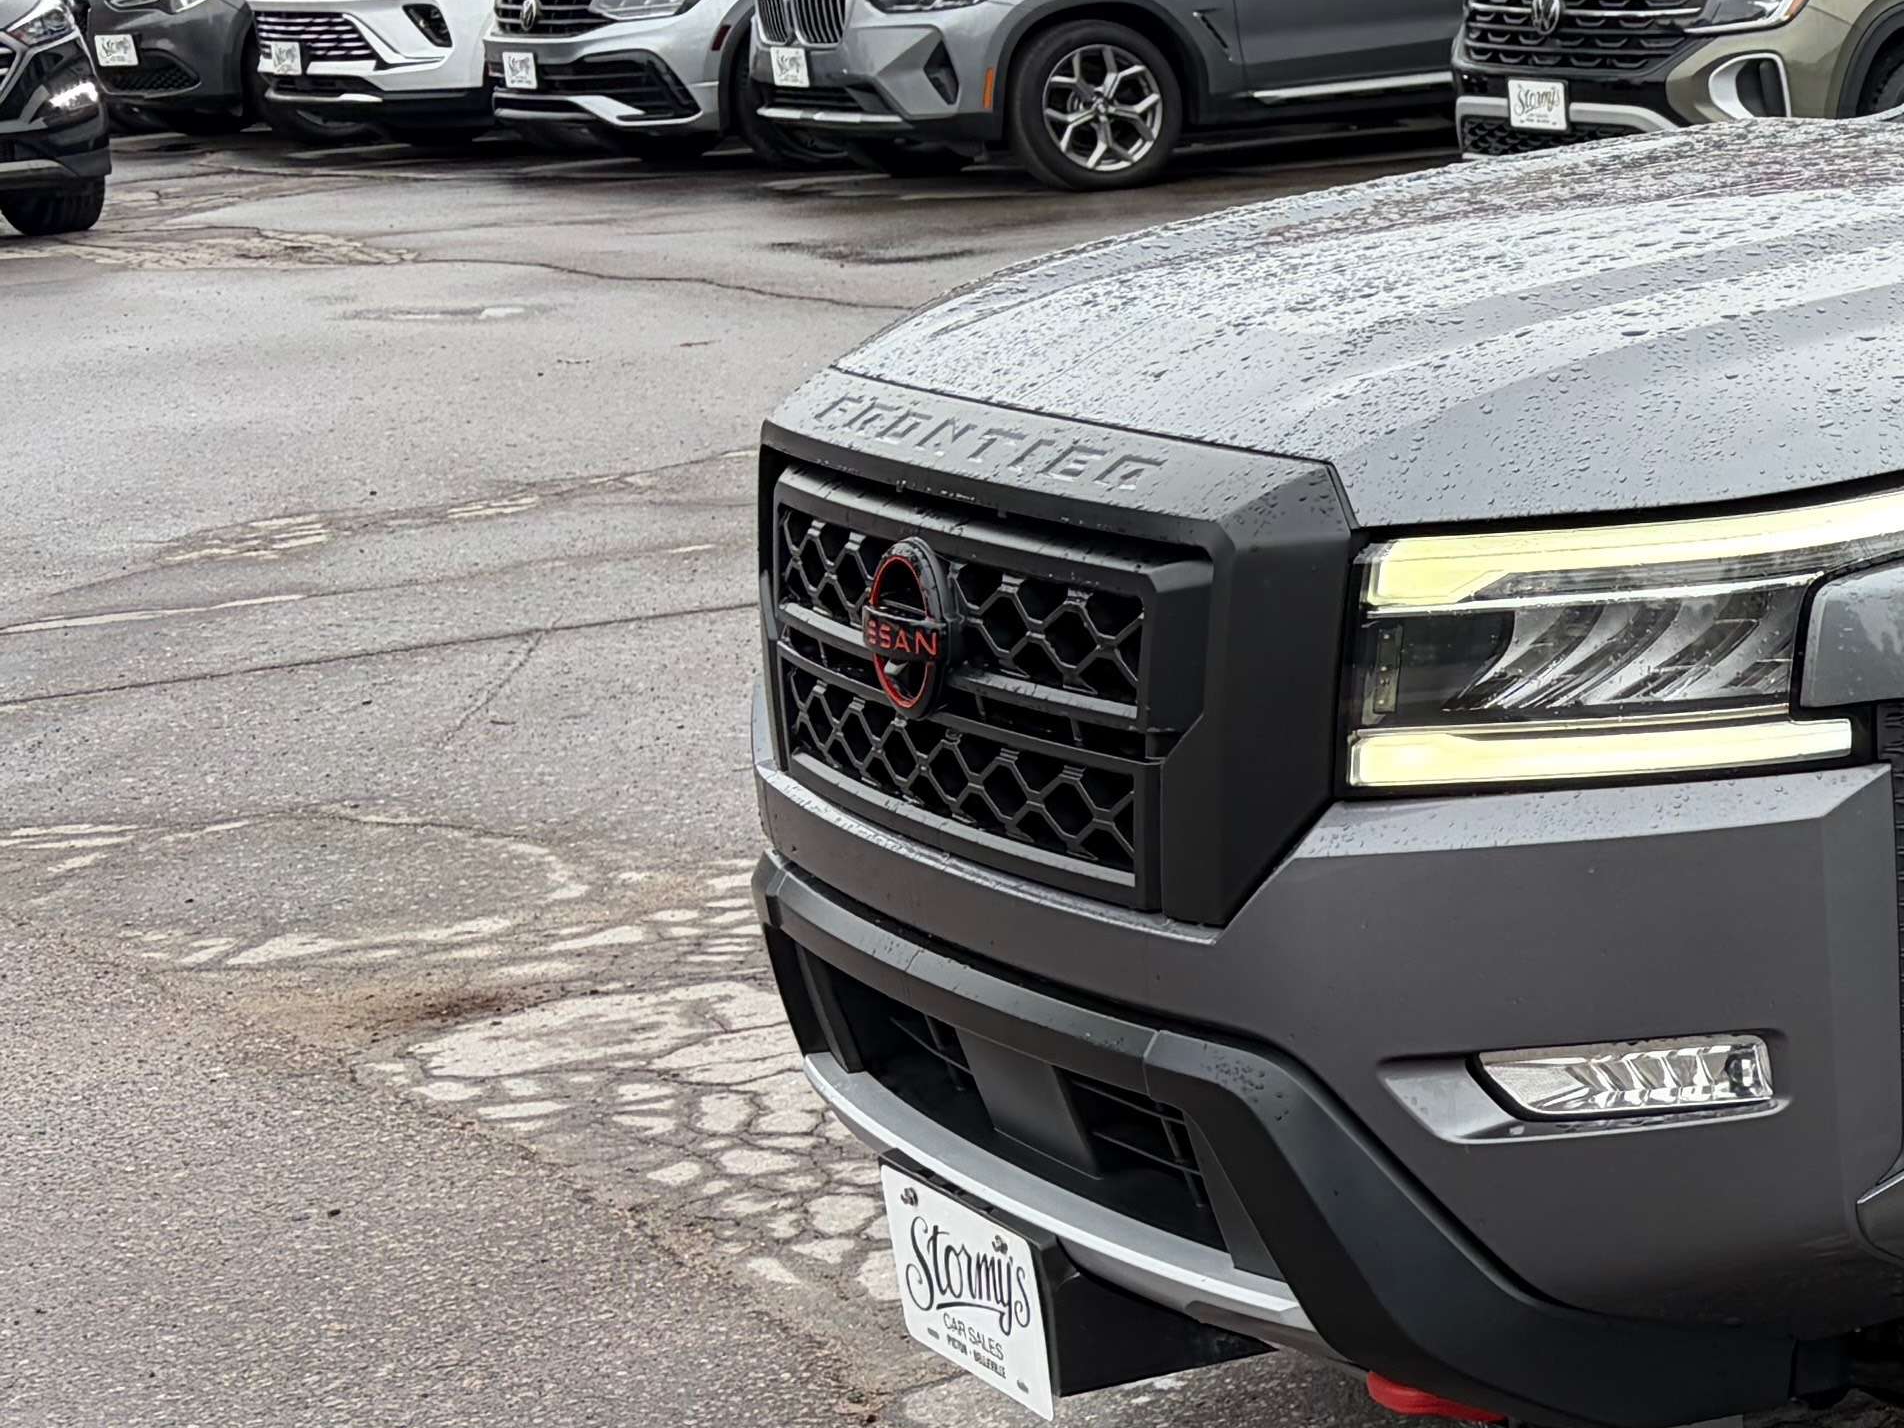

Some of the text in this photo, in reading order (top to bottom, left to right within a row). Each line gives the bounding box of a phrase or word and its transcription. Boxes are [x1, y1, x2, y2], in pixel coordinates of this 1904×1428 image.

[905, 1215, 1031, 1336] Stormy's
[943, 1312, 1004, 1361] CAR SALES
